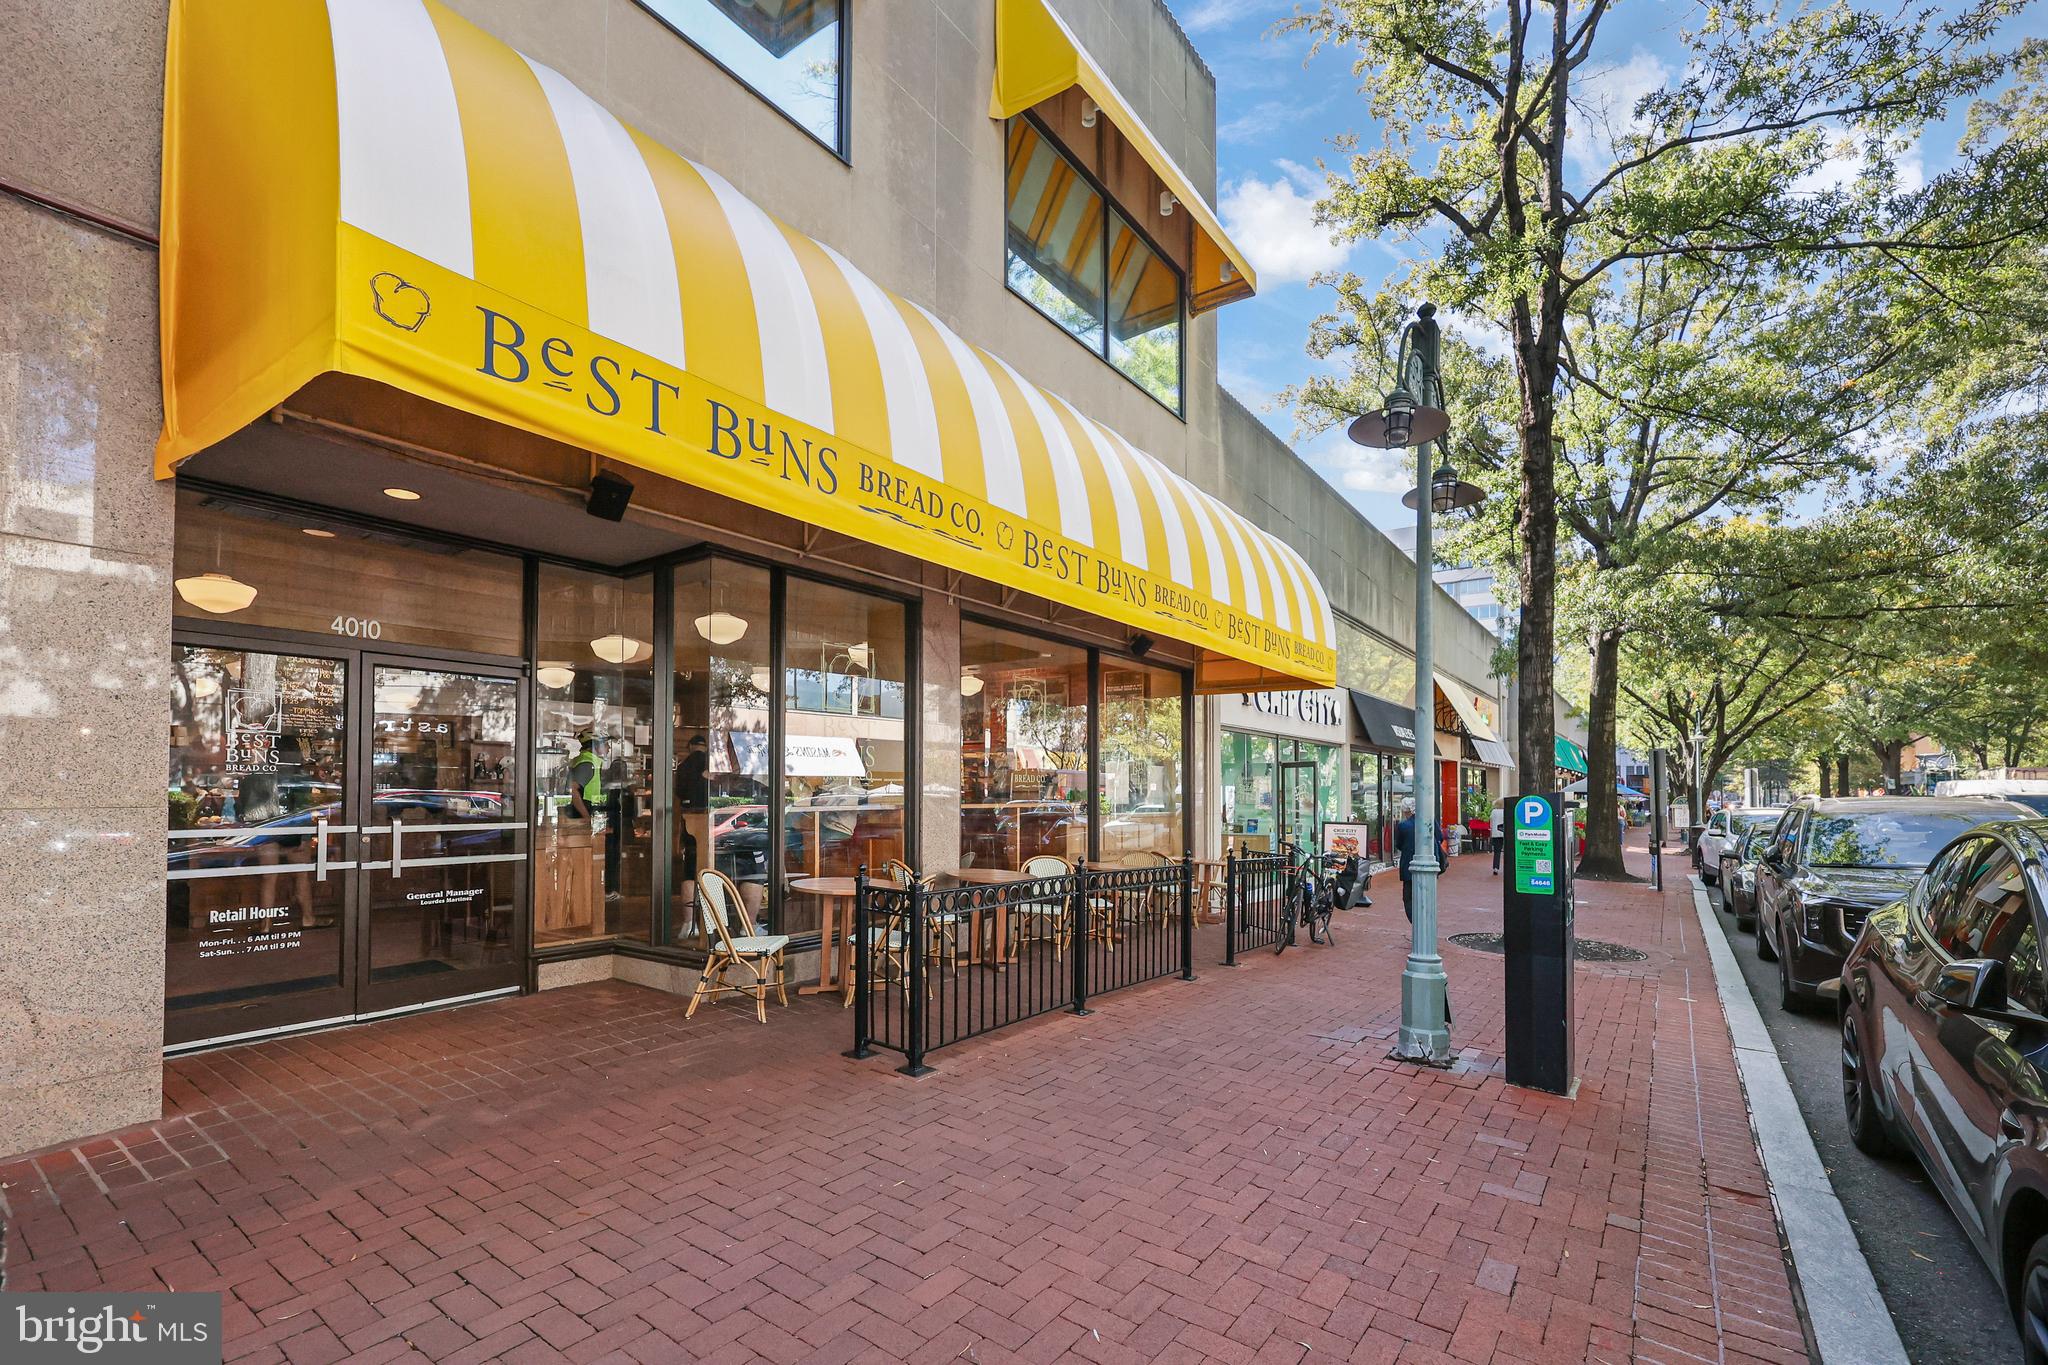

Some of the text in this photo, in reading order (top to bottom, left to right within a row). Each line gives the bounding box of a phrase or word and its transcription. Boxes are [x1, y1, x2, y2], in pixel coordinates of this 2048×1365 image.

[858, 462, 944, 519] BREAD
[950, 502, 985, 537] CO.
[1155, 584, 1191, 614] BREAD
[1193, 604, 1209, 621] CO.
[331, 615, 381, 640] 4010
[1294, 641, 1315, 660] BREAD
[293, 707, 324, 715] TOPPINGS
[1298, 689, 1334, 725] CITY
[1014, 774, 1036, 783] BREAD
[1524, 802, 1543, 824] P
[406, 888, 484, 900] General Manager
[420, 898, 445, 906] Lourdes
[209, 906, 289, 923] Retail Hours:
[247, 935, 253, 943] 6
[254, 933, 270, 942] AM
[271, 932, 279, 940] til
[280, 931, 287, 939] 9
[286, 940, 300, 948] PM
